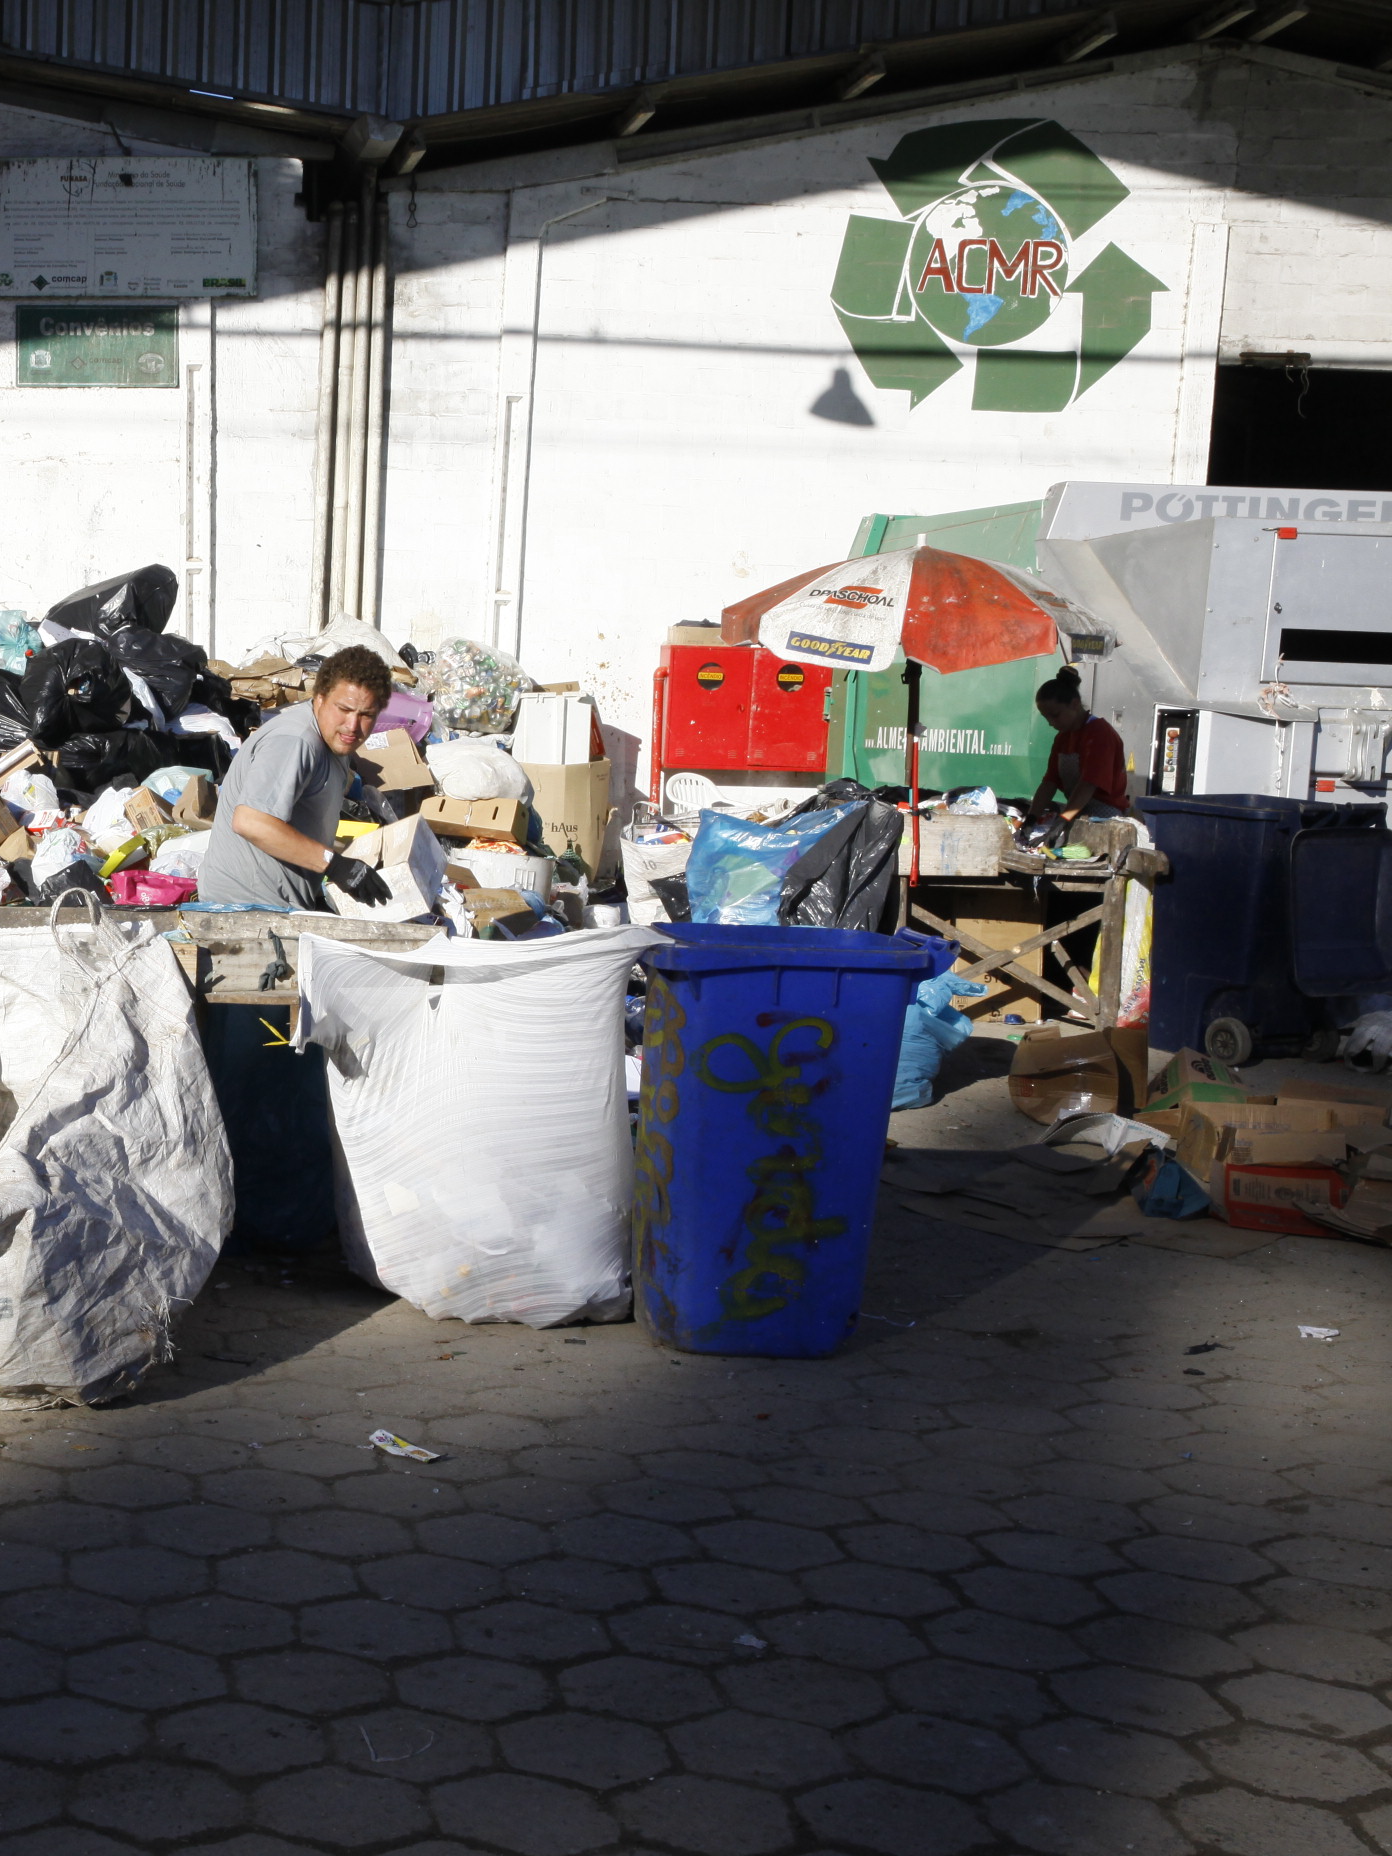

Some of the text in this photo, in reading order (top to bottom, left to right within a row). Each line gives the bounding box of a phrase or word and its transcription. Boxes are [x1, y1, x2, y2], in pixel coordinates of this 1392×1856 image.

[60, 175, 88, 183] FUNASA
[916, 237, 1064, 298] ACMR
[51, 274, 87, 285] comcap
[39, 316, 155, 337] Convênios
[790, 636, 872, 661] GOODYEAR
